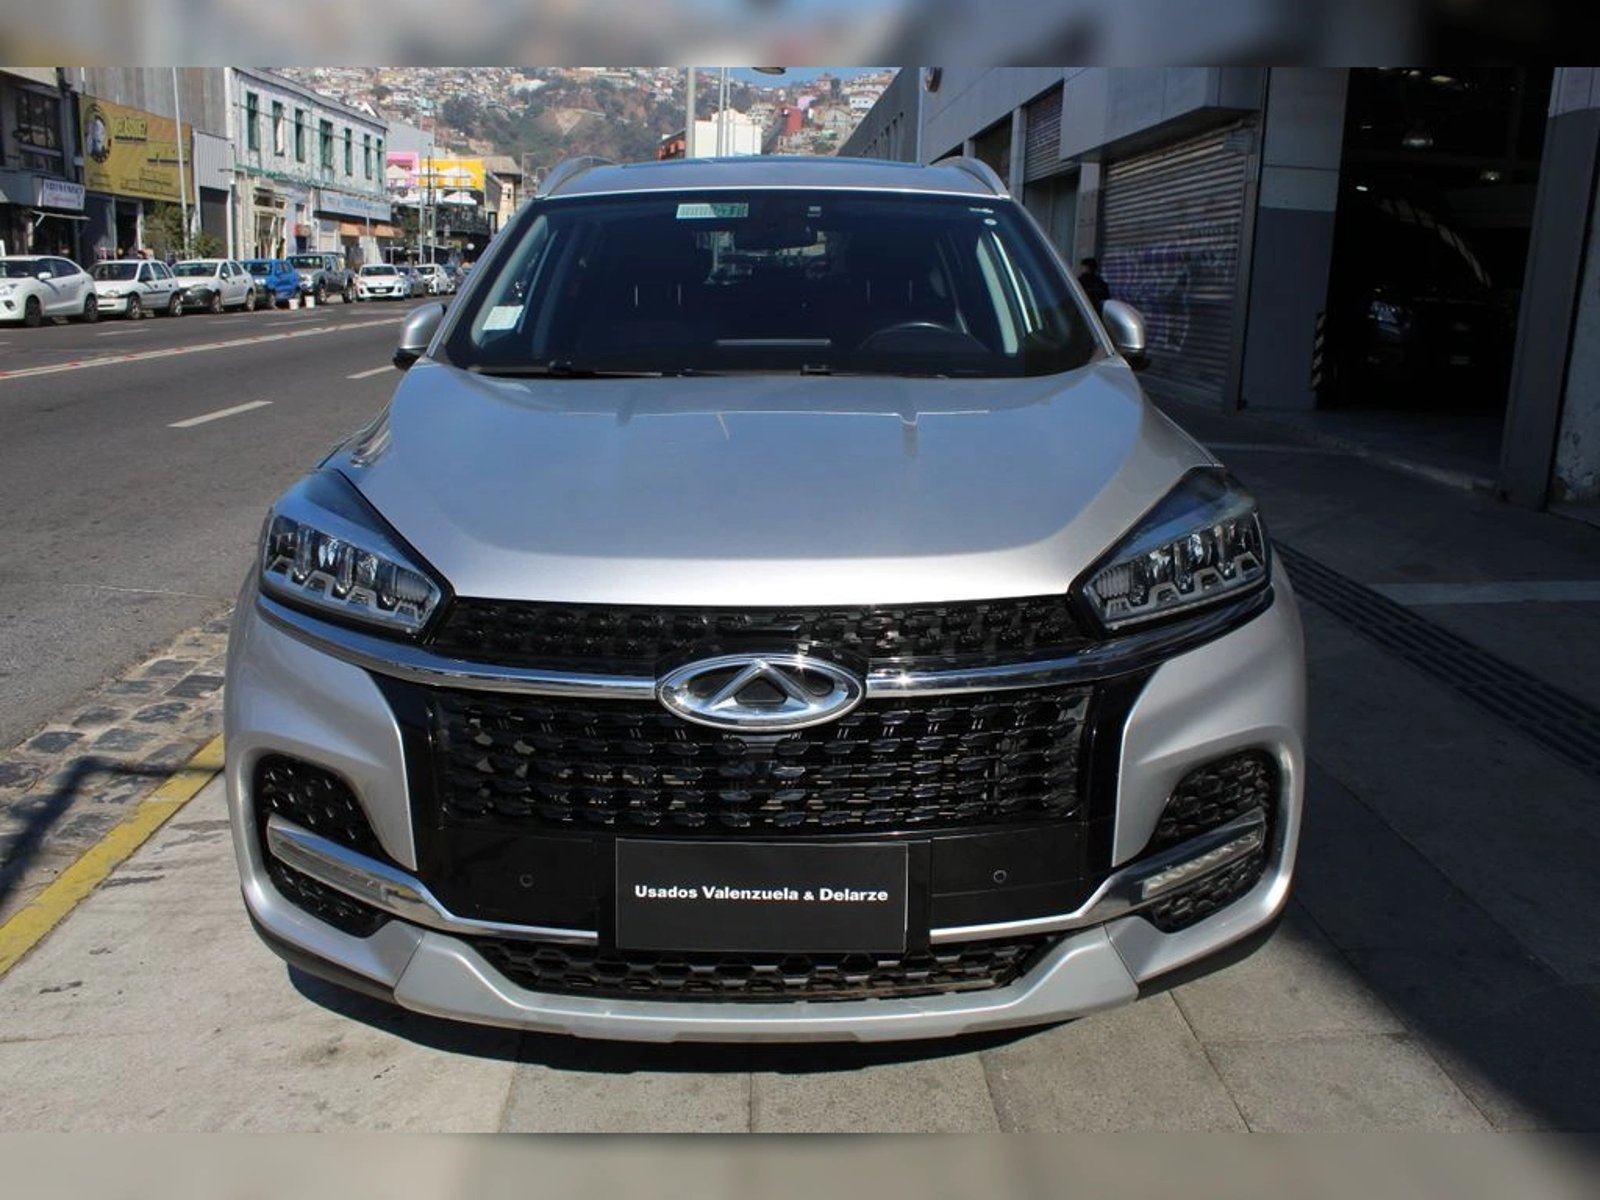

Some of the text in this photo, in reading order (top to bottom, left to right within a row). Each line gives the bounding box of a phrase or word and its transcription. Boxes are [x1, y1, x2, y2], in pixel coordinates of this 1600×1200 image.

[634, 885, 889, 902] Usados Valenzuela & Delarze
